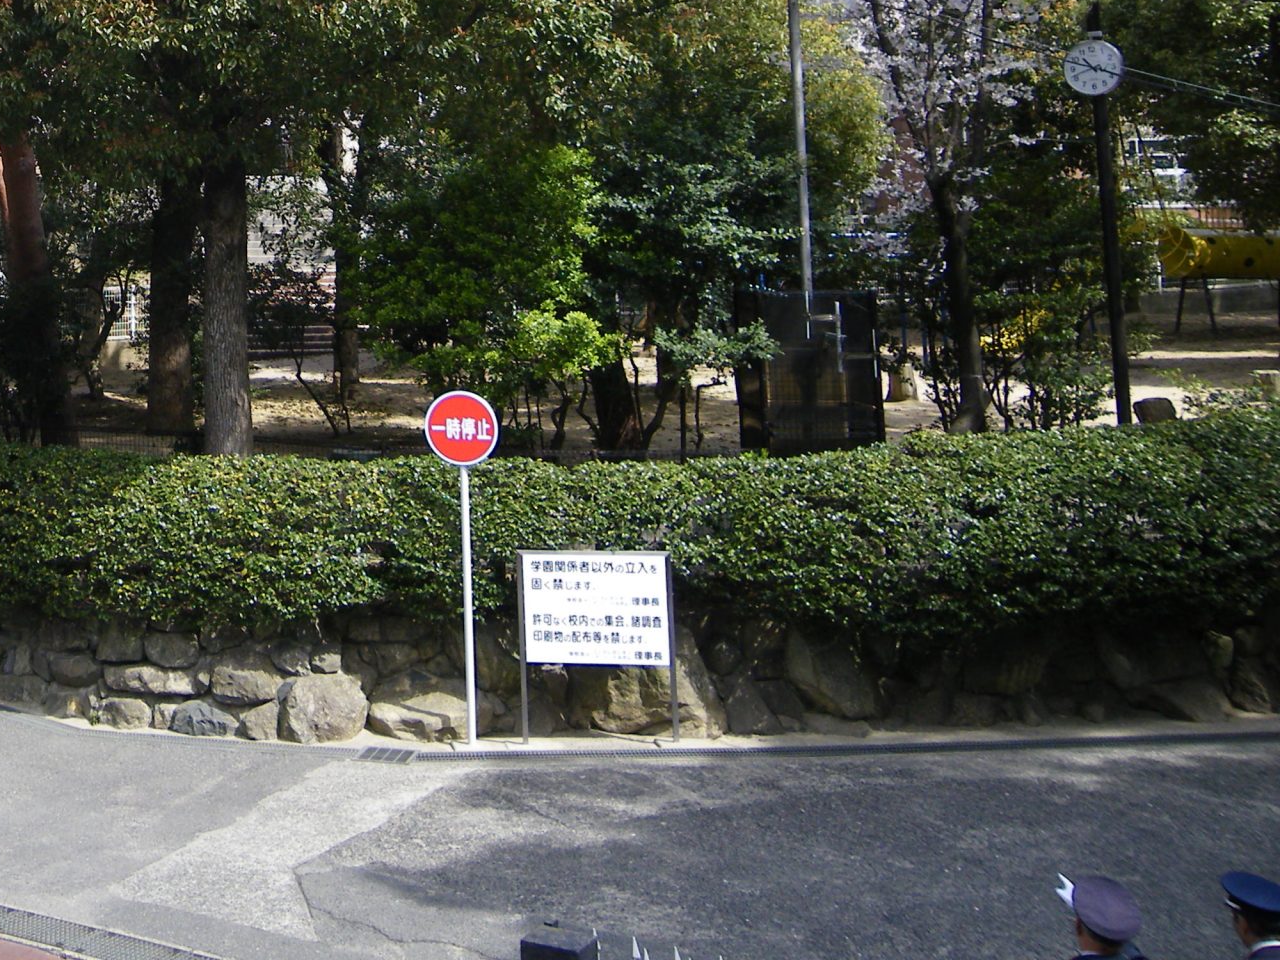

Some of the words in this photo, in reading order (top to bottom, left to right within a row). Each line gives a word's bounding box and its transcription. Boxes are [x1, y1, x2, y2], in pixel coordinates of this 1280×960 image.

[431, 417, 492, 440] 一時停止
[531, 560, 657, 575] 学園関係者以外の立入を
[632, 597, 659, 606] 理事長
[634, 651, 662, 660] 理事長
